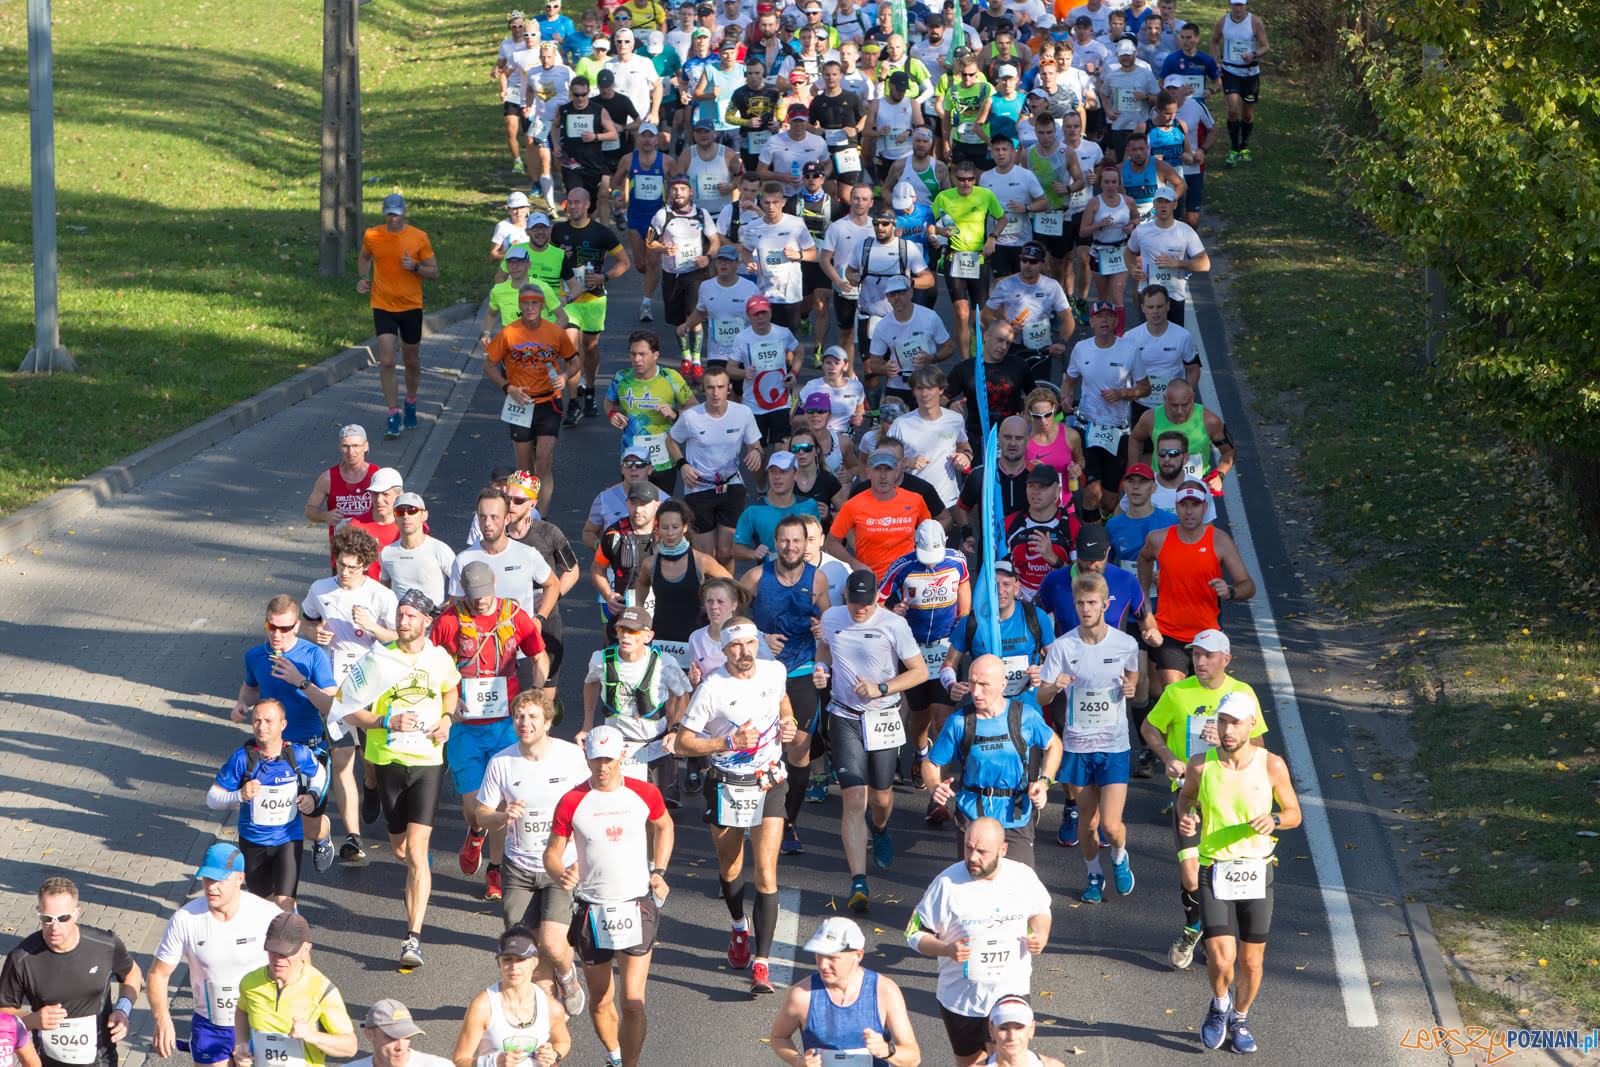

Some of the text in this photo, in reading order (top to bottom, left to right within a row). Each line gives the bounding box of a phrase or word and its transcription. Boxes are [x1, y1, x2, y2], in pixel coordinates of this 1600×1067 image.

[640, 183, 657, 191] 3616
[1040, 217, 1058, 225] 2914
[959, 260, 975, 268] 1425
[1155, 273, 1171, 281] 903
[718, 326, 740, 336] 3408
[1028, 329, 1047, 340] 3667
[757, 350, 778, 360] 5159
[507, 403, 526, 415] 2172
[335, 500, 372, 511] SZPIKU
[1004, 671, 1022, 681] 28
[476, 691, 499, 702] 855
[1079, 701, 1110, 712] 2630
[873, 721, 901, 733] 4760
[980, 743, 1004, 752] TEAM
[260, 799, 292, 810] 4046
[729, 799, 758, 810] 2535
[1224, 870, 1258, 882] 4206
[601, 917, 633, 931] 2460
[980, 950, 1010, 964] 3717
[50, 1034, 89, 1046] 5040
[264, 1048, 289, 1061] 816
